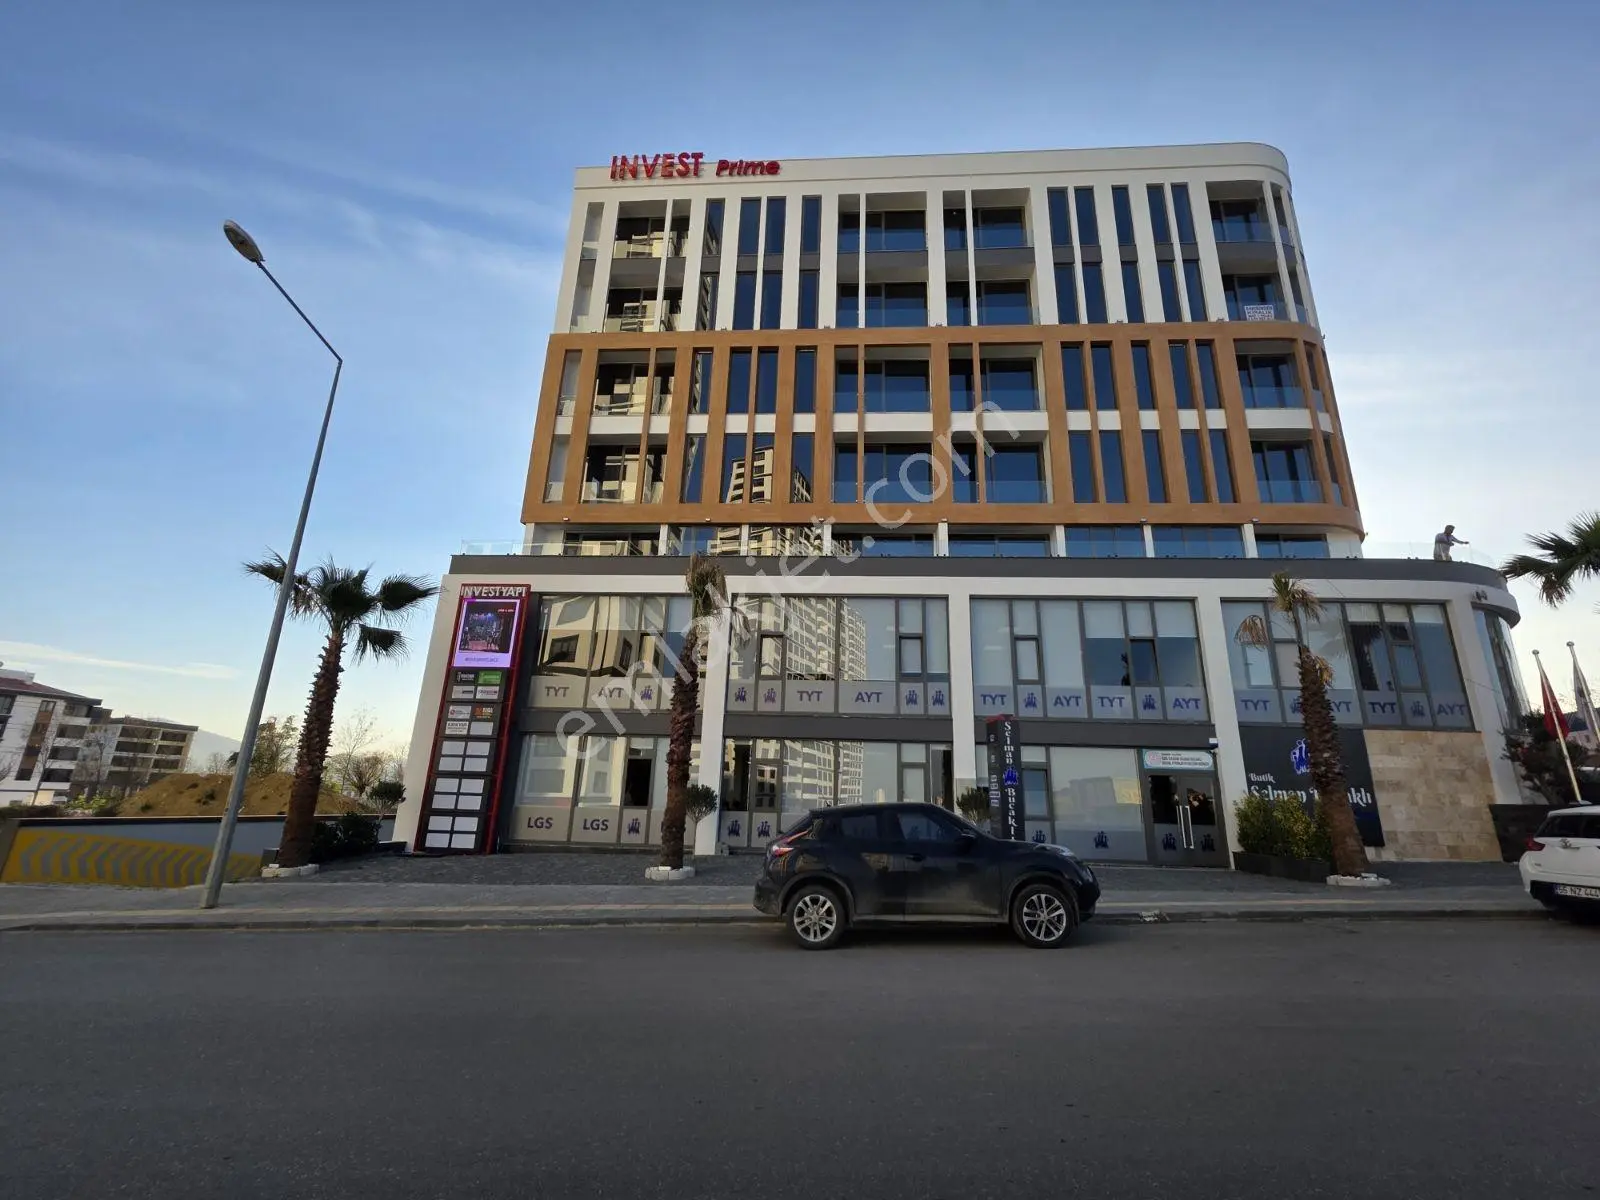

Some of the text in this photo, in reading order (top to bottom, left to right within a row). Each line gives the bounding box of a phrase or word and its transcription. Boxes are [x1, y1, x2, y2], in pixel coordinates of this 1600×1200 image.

[610, 152, 781, 180] INVEST Prime
[545, 686, 570, 698] TYT
[797, 690, 823, 702] TYT
[854, 692, 882, 703] AYT
[980, 694, 1007, 706] TYT
[1053, 695, 1082, 707] AYT
[1098, 696, 1126, 708] TYT
[1172, 697, 1201, 709] AYT
[1240, 700, 1270, 711] TYT
[1331, 701, 1352, 712] YT
[1368, 702, 1397, 714] TYT
[1437, 703, 1466, 716] AYT
[527, 817, 554, 829] LGS
[582, 818, 609, 831] LGS
